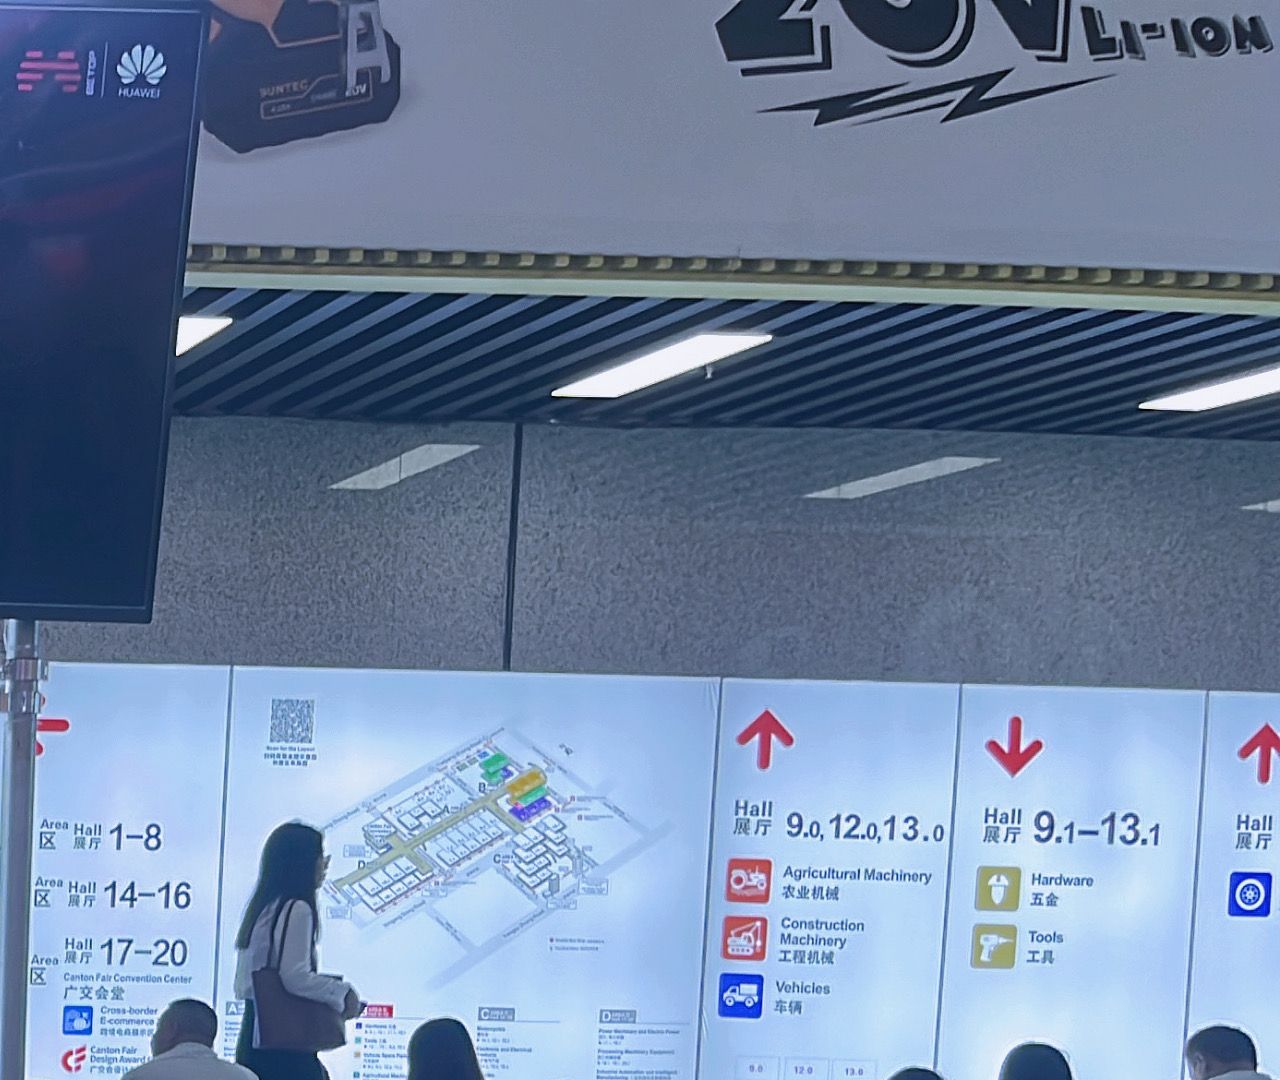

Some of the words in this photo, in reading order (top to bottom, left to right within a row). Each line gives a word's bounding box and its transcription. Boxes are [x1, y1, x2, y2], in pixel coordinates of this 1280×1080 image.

[117, 86, 161, 100] HUAWEI
[258, 78, 311, 99] SUNTEC
[734, 800, 773, 817] Hall
[984, 808, 1022, 825] Hall
[1236, 814, 1273, 831] Hall
[40, 819, 69, 830] Area
[73, 823, 102, 836] Hall
[733, 818, 772, 836] 展厅
[40, 831, 56, 849] 区
[983, 825, 1022, 843] 展厅
[1235, 832, 1273, 850] 展厅
[73, 837, 102, 850] 展厅
[35, 876, 64, 888] Area
[783, 865, 861, 882] Agricultural
[863, 868, 933, 886] Machinery
[1031, 873, 1094, 887] Hardware
[68, 881, 97, 894] Hall
[782, 885, 840, 901] 农业机械
[34, 889, 51, 907] 区
[67, 895, 96, 908] 展厅
[1029, 892, 1060, 907] 五金
[781, 916, 865, 932] Construction
[64, 937, 93, 950] Hall
[780, 933, 847, 950] Machinery
[1028, 930, 1064, 944] Tools
[31, 954, 59, 965] Area
[64, 951, 93, 964] 展厅
[778, 950, 835, 965] 工程机械
[1026, 950, 1055, 964] 工具
[30, 967, 46, 985] 区
[63, 972, 95, 983] Canton
[96, 972, 113, 983] Fair
[114, 973, 163, 984] Convention
[163, 974, 193, 985] Center
[63, 985, 126, 1000] 广交会堂
[775, 980, 831, 995] Vehicles
[100, 1006, 159, 1016] Cross-border
[773, 1000, 803, 1015] 车辆
[100, 1017, 155, 1026] E-commerce
[90, 1046, 121, 1055] Canton
[121, 1046, 138, 1055] Fair
[90, 1055, 117, 1066] Design
[118, 1056, 147, 1065] Award
